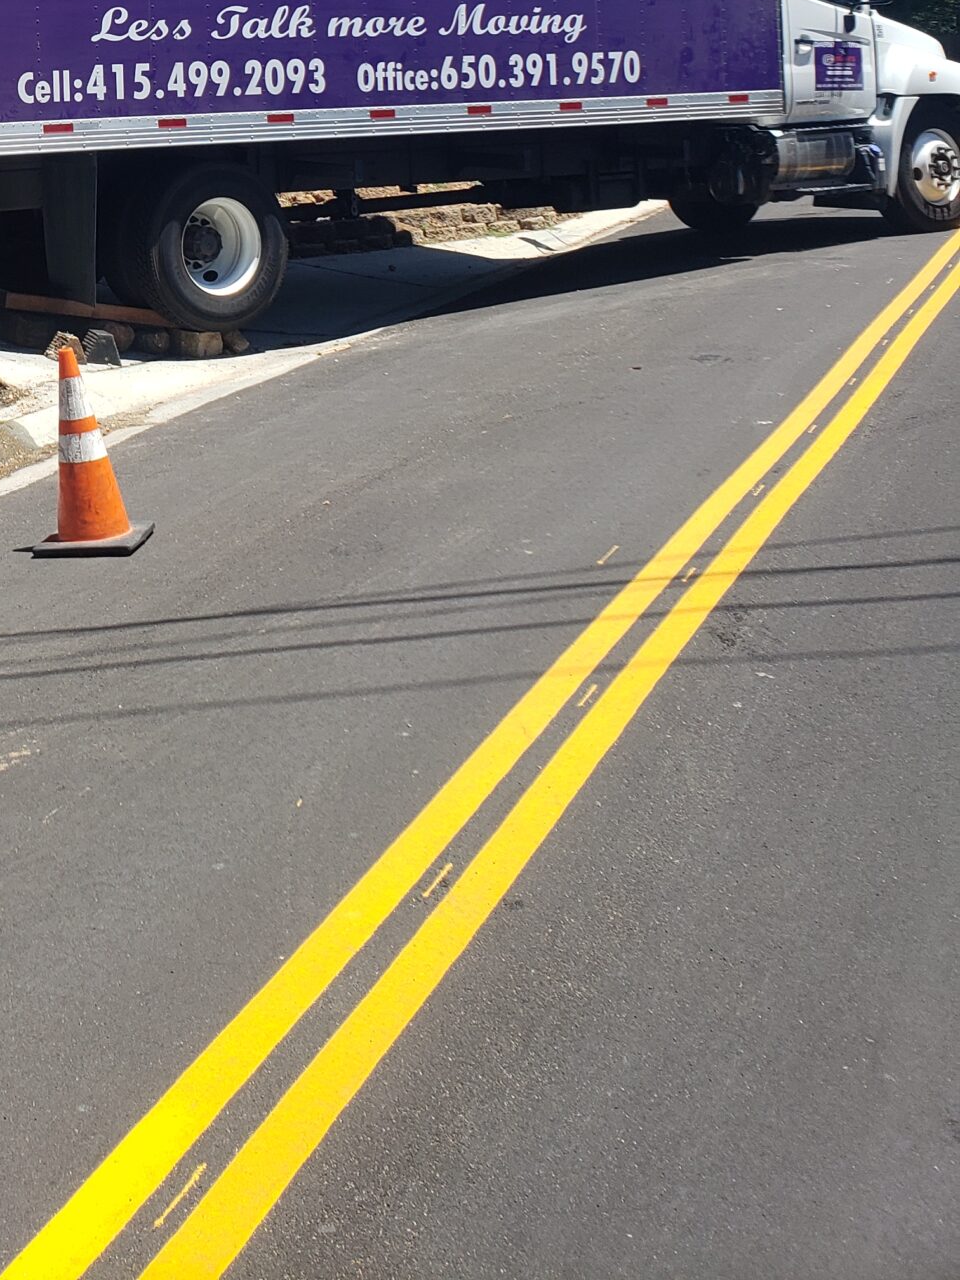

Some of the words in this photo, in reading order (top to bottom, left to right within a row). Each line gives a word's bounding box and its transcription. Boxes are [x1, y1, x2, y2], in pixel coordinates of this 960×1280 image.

[91, 6, 192, 42] Less
[211, 5, 316, 40] Talk
[327, 16, 427, 38] more
[438, 3, 587, 44] Moving
